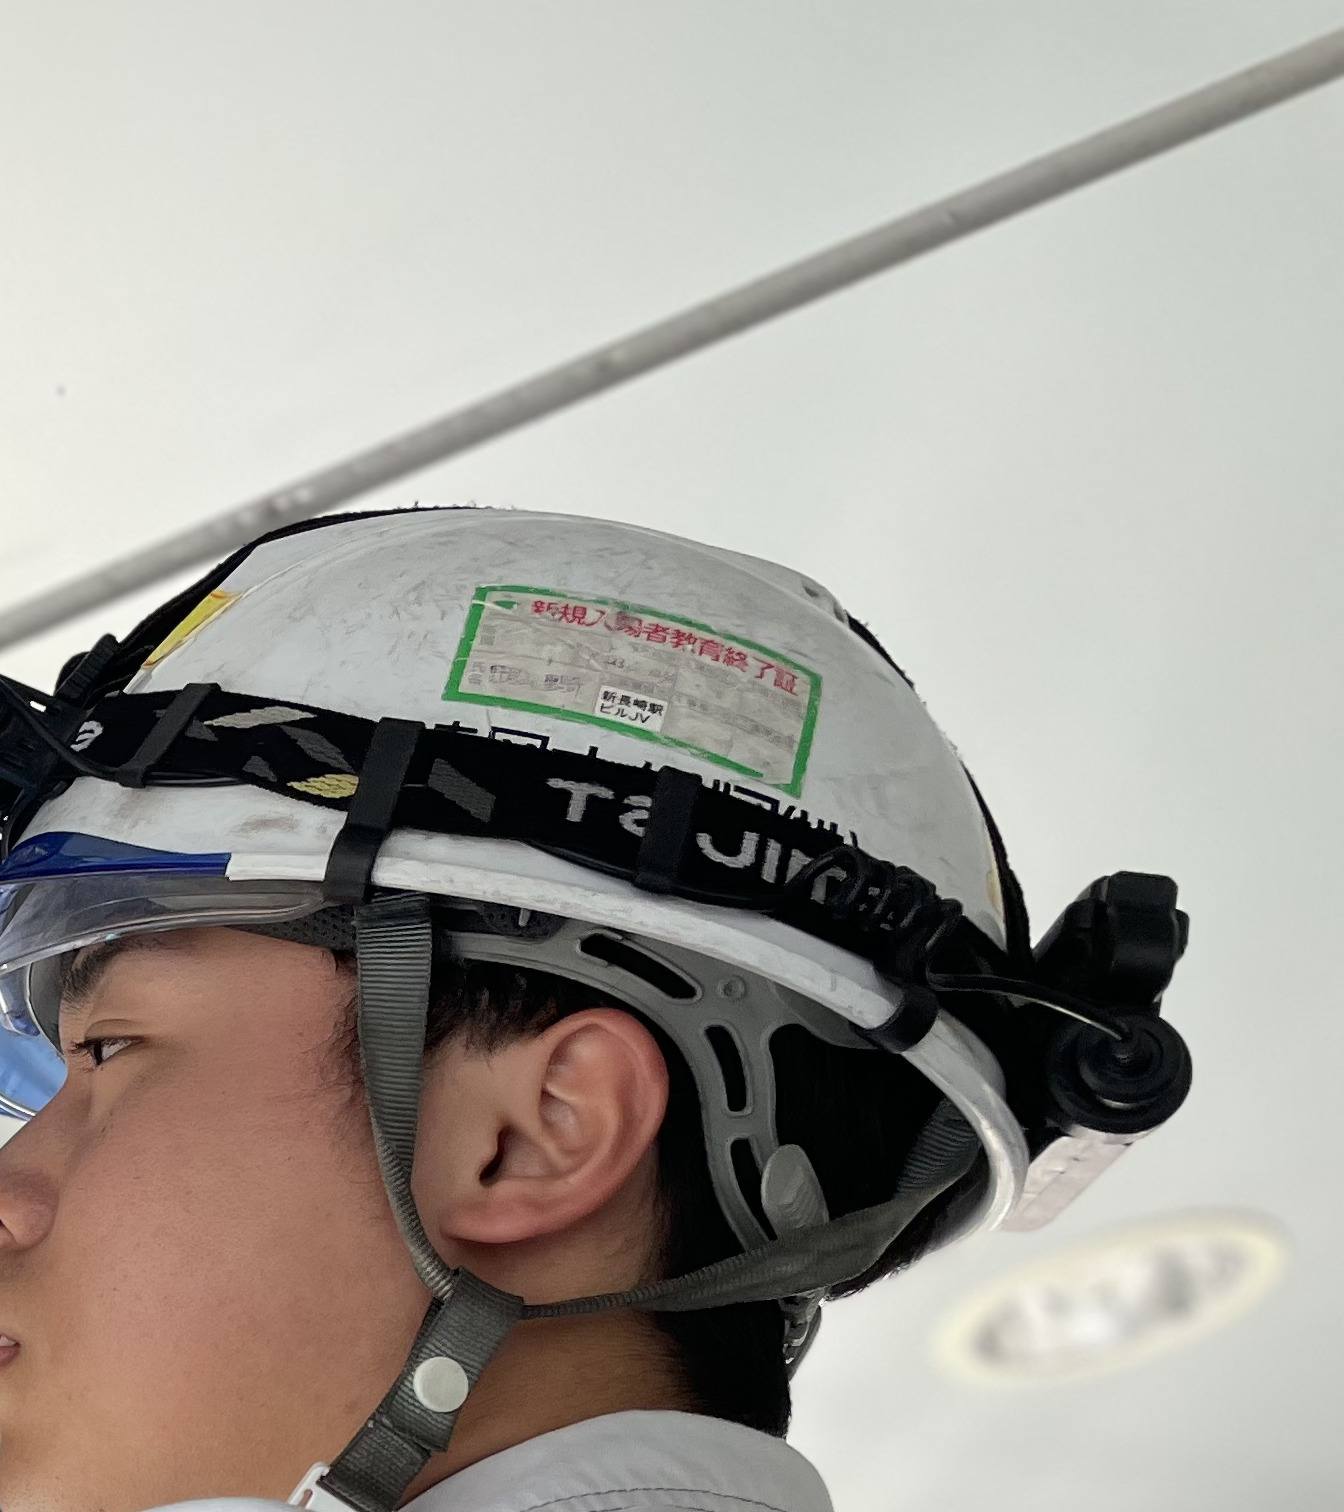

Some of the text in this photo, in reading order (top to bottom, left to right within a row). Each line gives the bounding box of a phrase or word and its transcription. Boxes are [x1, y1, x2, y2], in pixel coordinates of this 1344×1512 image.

[600, 703, 650, 723] ビルJV
[602, 690, 664, 716] 新長崎駅
